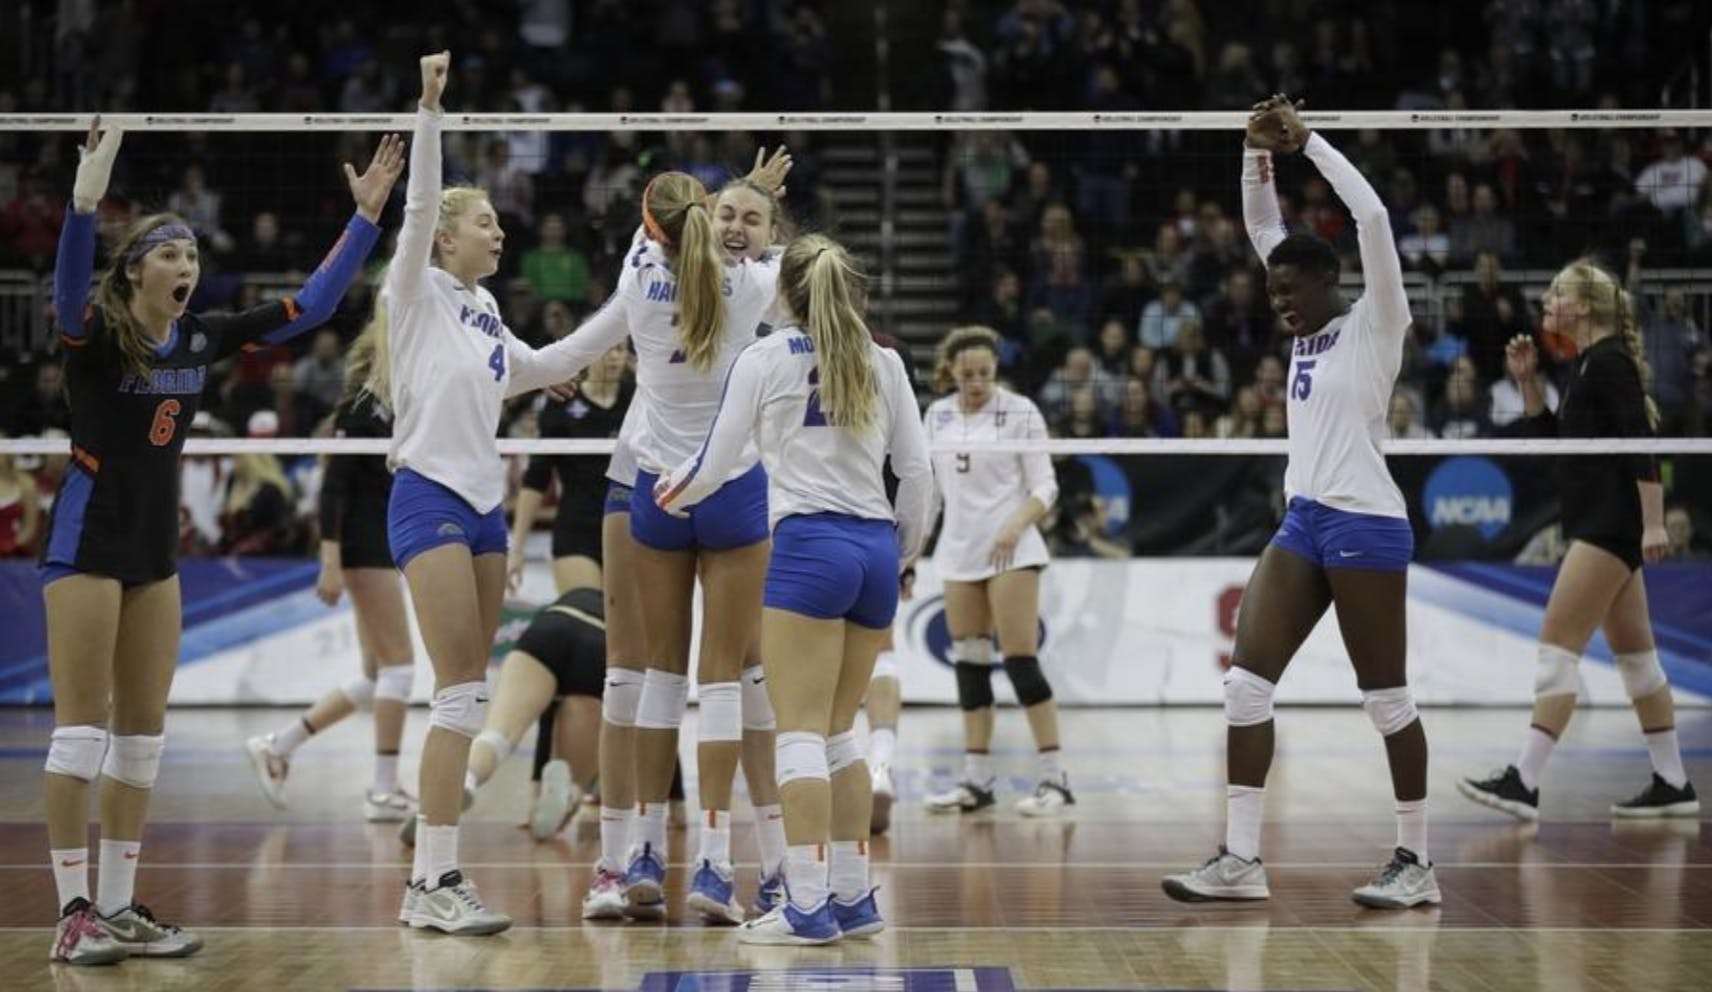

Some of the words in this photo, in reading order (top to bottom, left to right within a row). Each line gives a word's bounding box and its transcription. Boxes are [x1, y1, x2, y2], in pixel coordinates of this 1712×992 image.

[488, 343, 506, 382] 4
[1291, 360, 1317, 401] 15
[148, 398, 181, 446] 6
[1431, 495, 1511, 526] NCAA
